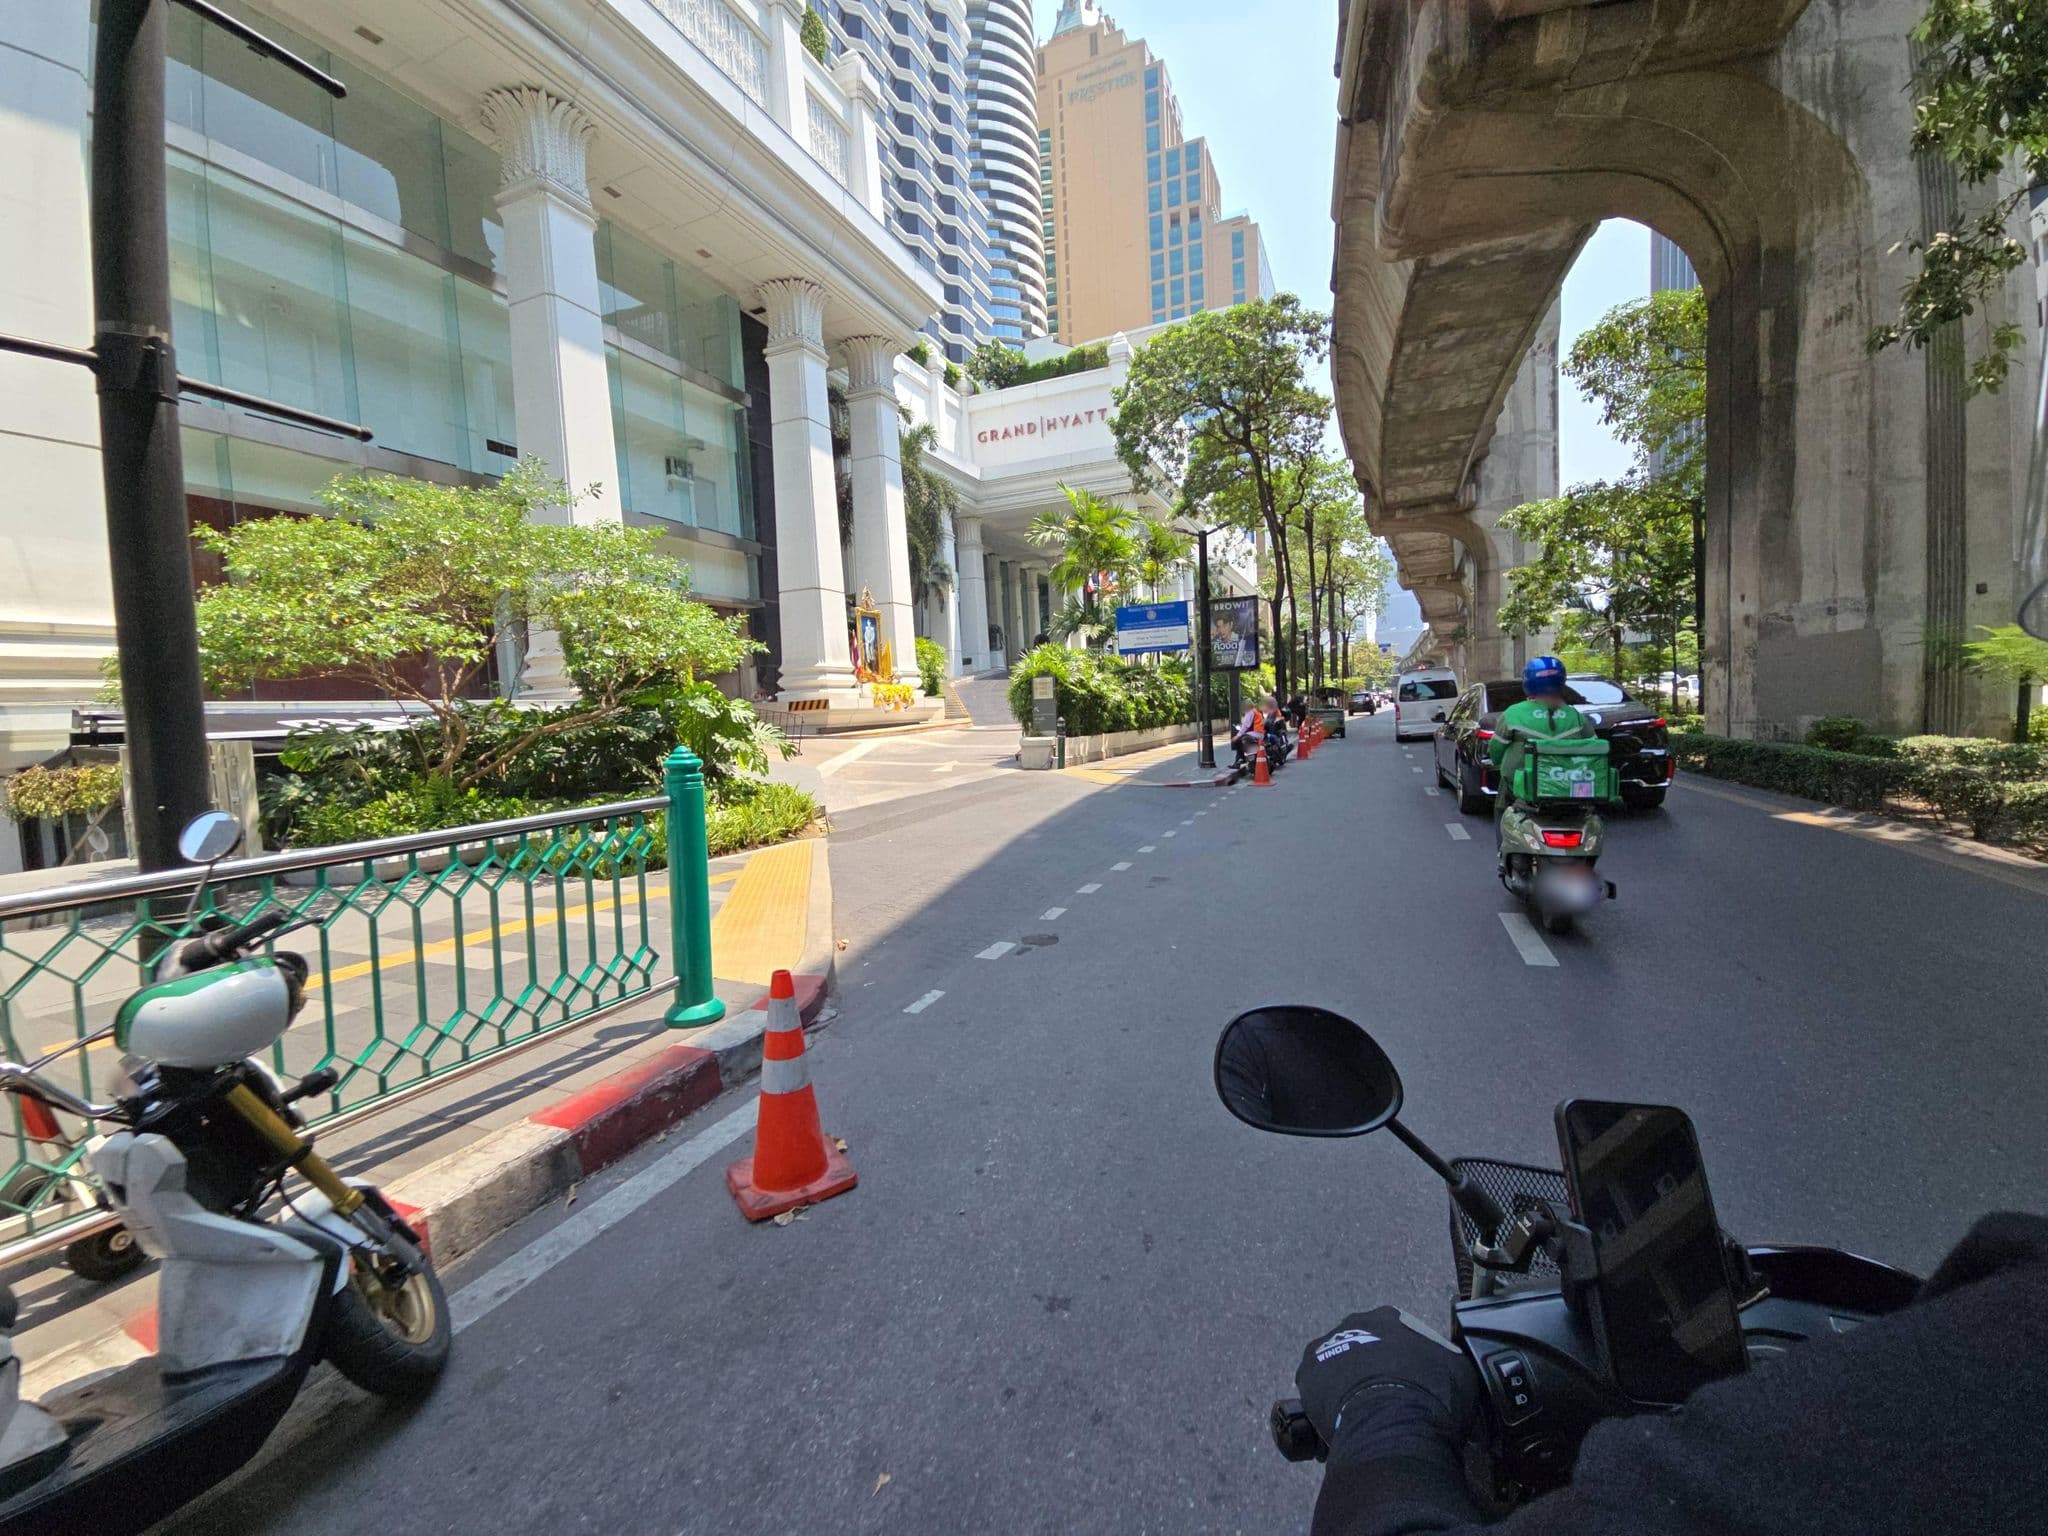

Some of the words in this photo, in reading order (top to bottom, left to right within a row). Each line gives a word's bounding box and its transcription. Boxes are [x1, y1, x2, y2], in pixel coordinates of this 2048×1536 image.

[977, 421, 1037, 444] GRAND
[1047, 407, 1108, 432] HYATT
[1214, 601, 1249, 611] BROWIT
[1549, 766, 1596, 781] Grab
